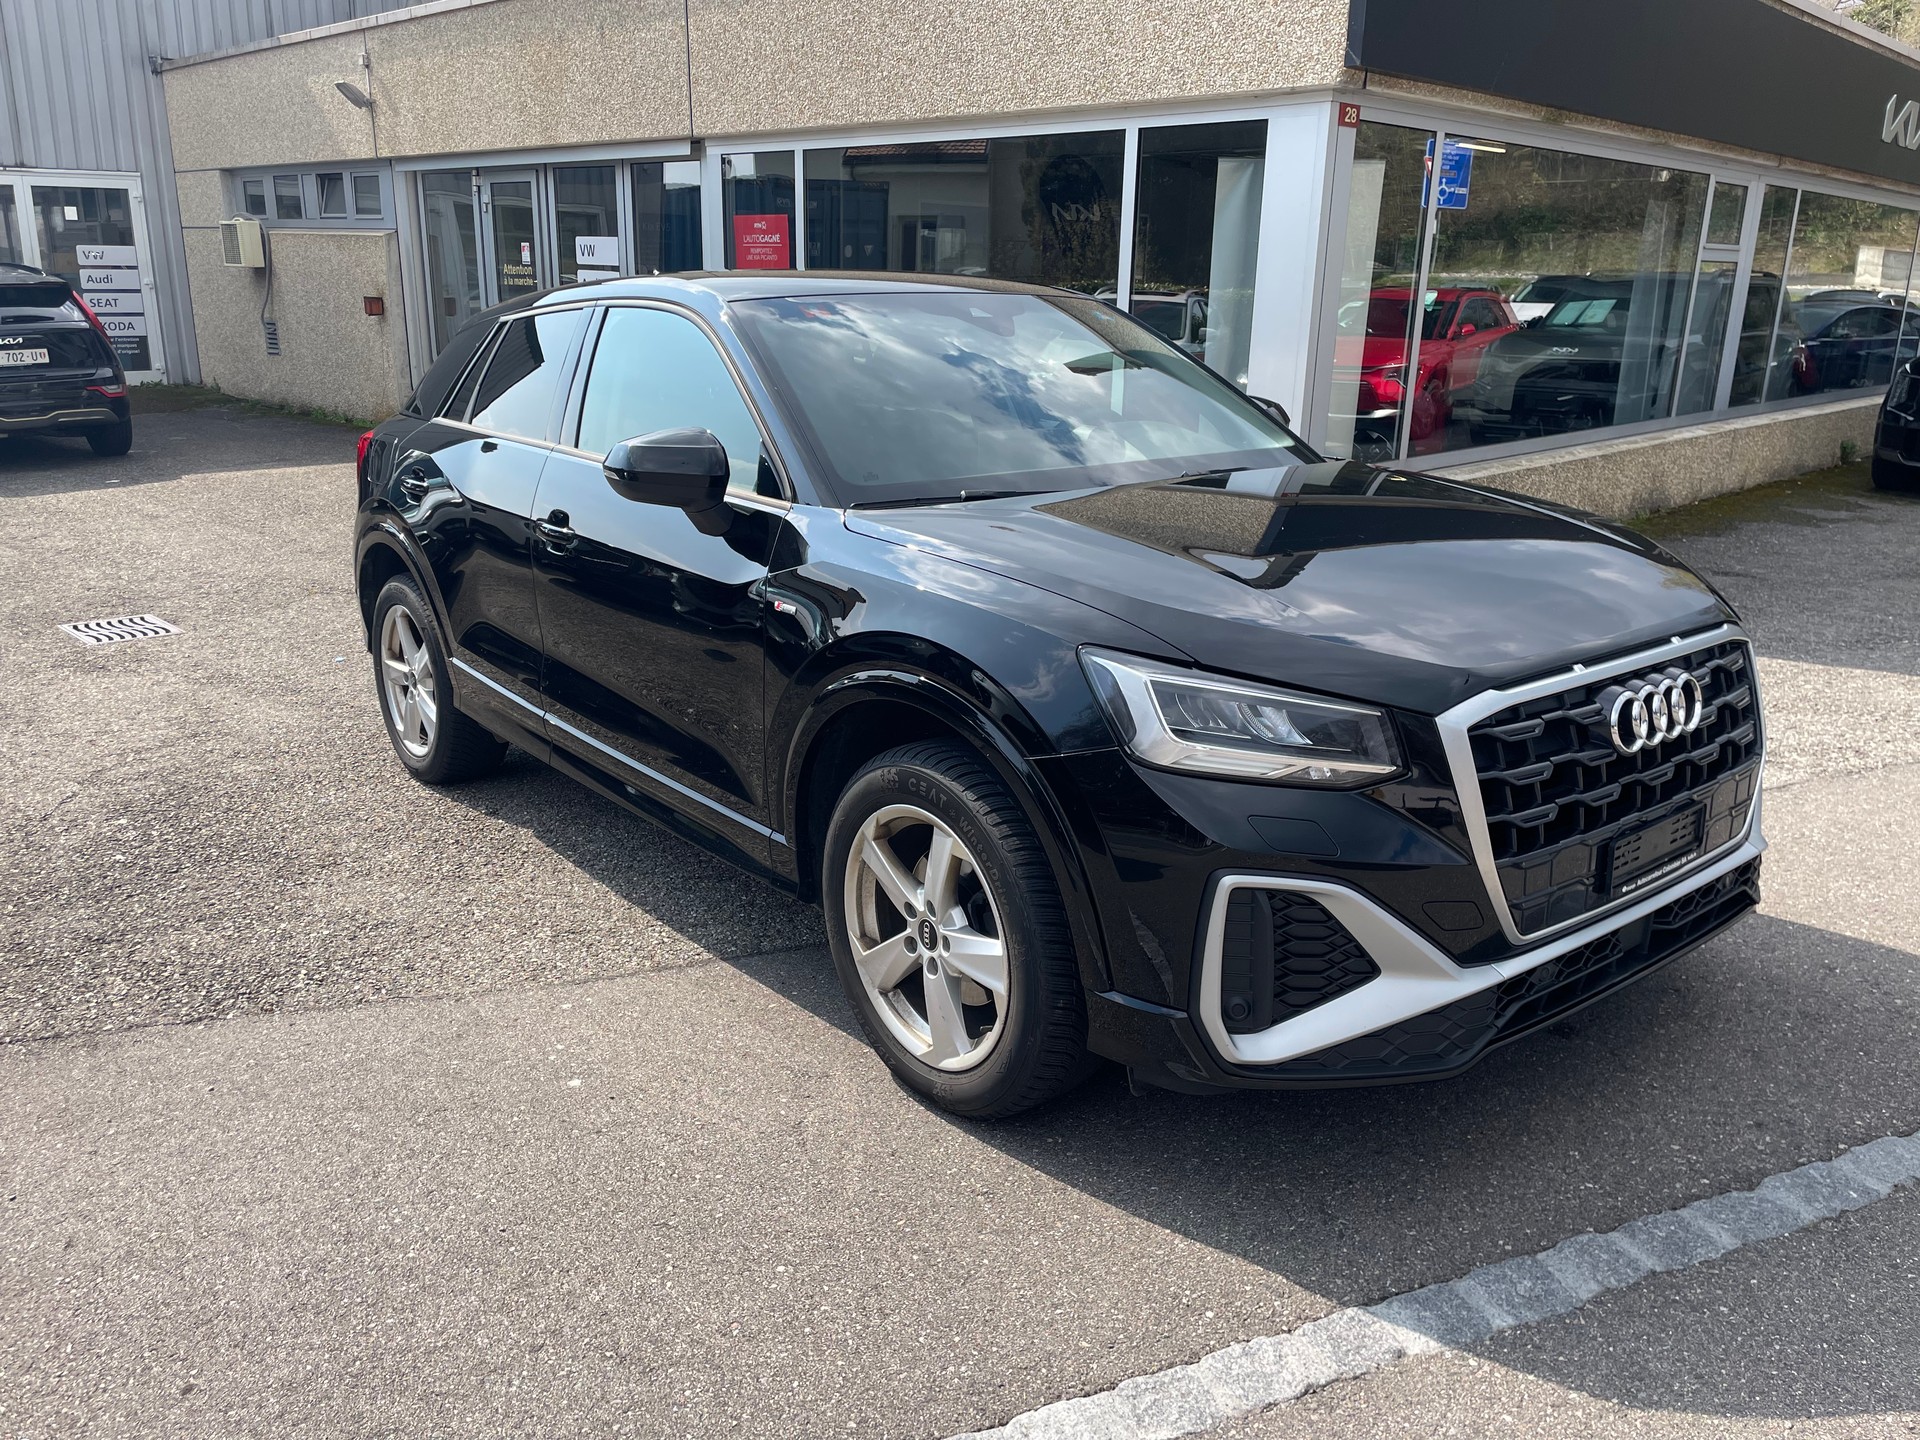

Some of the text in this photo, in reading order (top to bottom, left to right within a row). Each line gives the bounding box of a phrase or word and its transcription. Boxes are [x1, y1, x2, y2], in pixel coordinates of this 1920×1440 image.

[1344, 106, 1358, 123] 28
[1881, 93, 1920, 150] KI
[82, 250, 105, 260] VW
[579, 244, 596, 257] VW
[503, 263, 533, 275] Attention
[86, 274, 113, 284] Audi
[508, 276, 514, 286] la
[513, 276, 534, 286] marche
[89, 298, 119, 308] SEAT
[101, 321, 136, 332] KODA
[908, 778, 948, 809] CEAT
